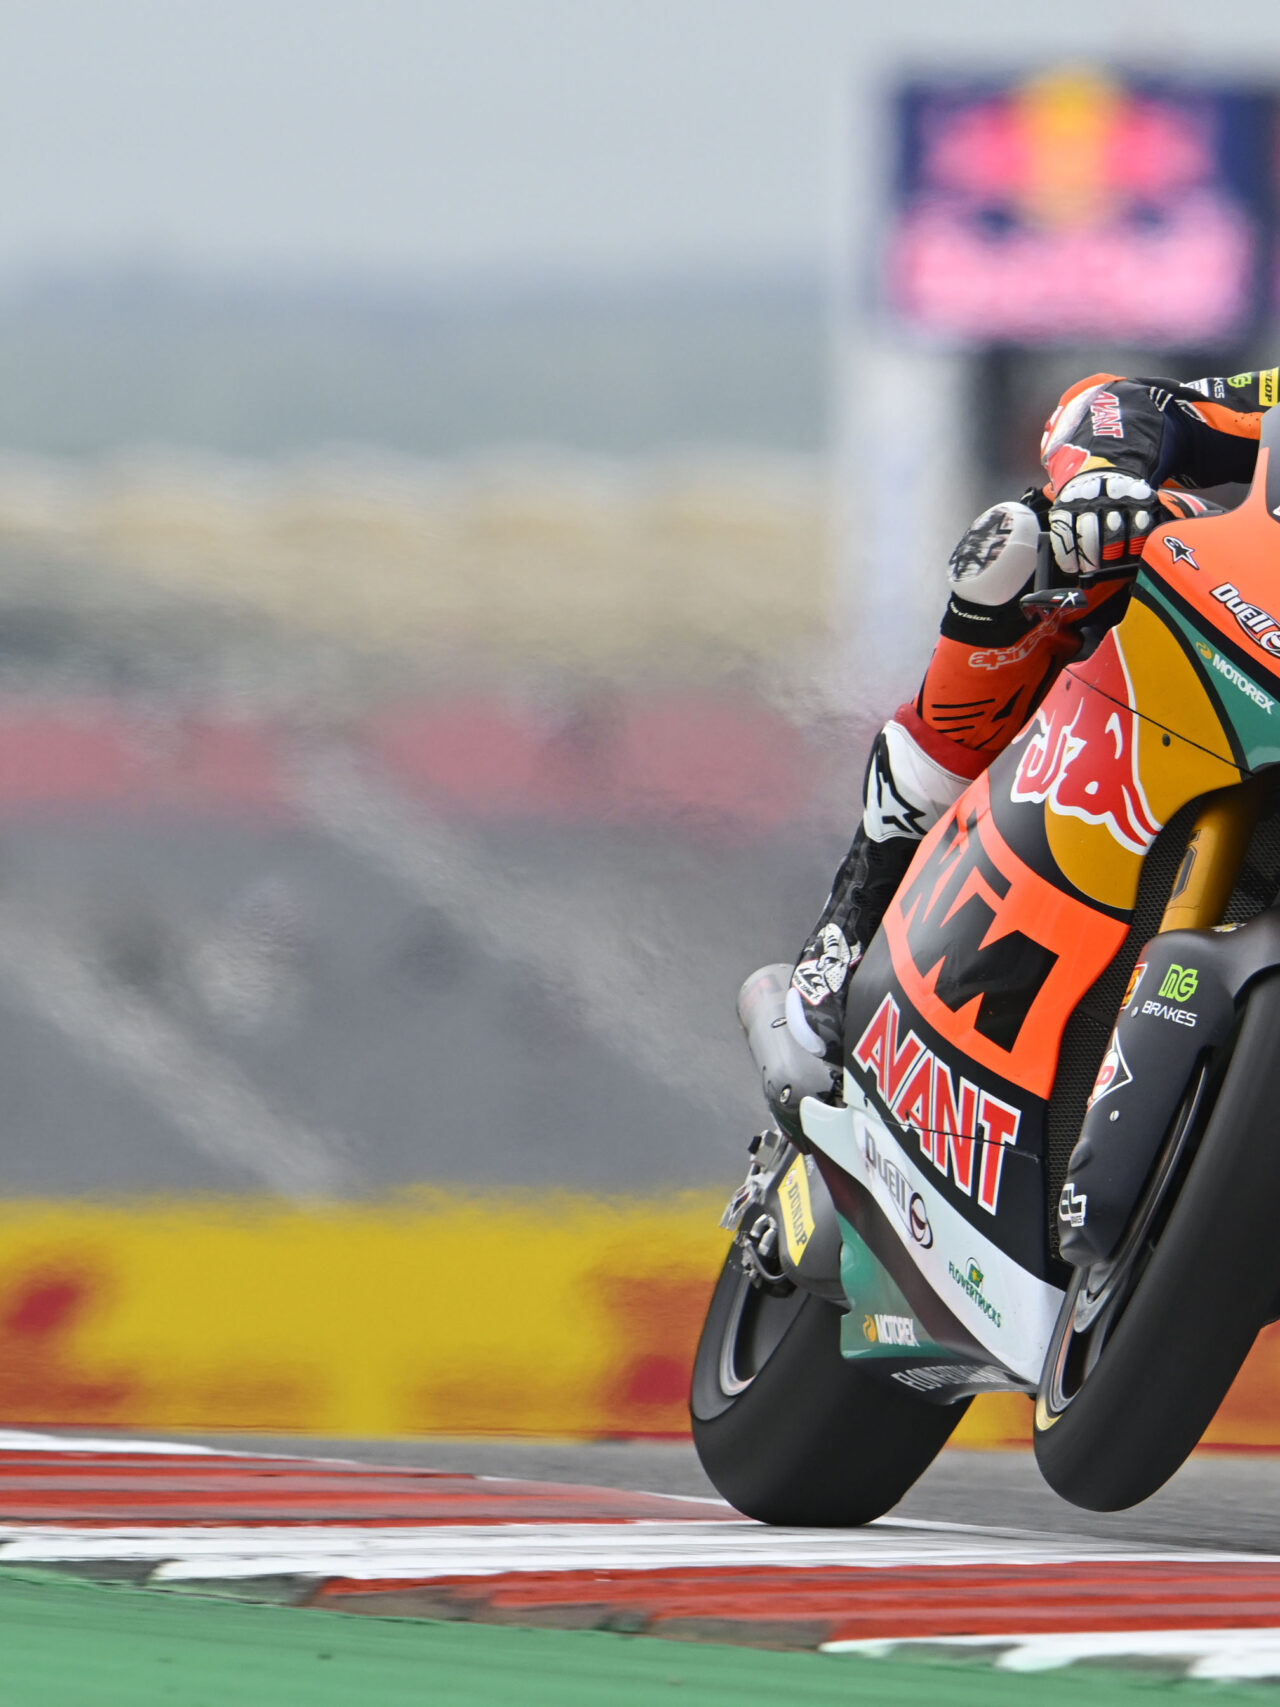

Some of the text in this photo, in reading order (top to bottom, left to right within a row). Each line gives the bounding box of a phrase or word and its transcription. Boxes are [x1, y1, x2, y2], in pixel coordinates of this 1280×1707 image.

[1090, 391, 1124, 438] AVANT
[1212, 652, 1275, 715] MOTOREX
[1141, 1000, 1199, 1028] BRAKES
[852, 992, 1021, 1216] AVANT
[787, 1181, 809, 1247] DUNLOP
